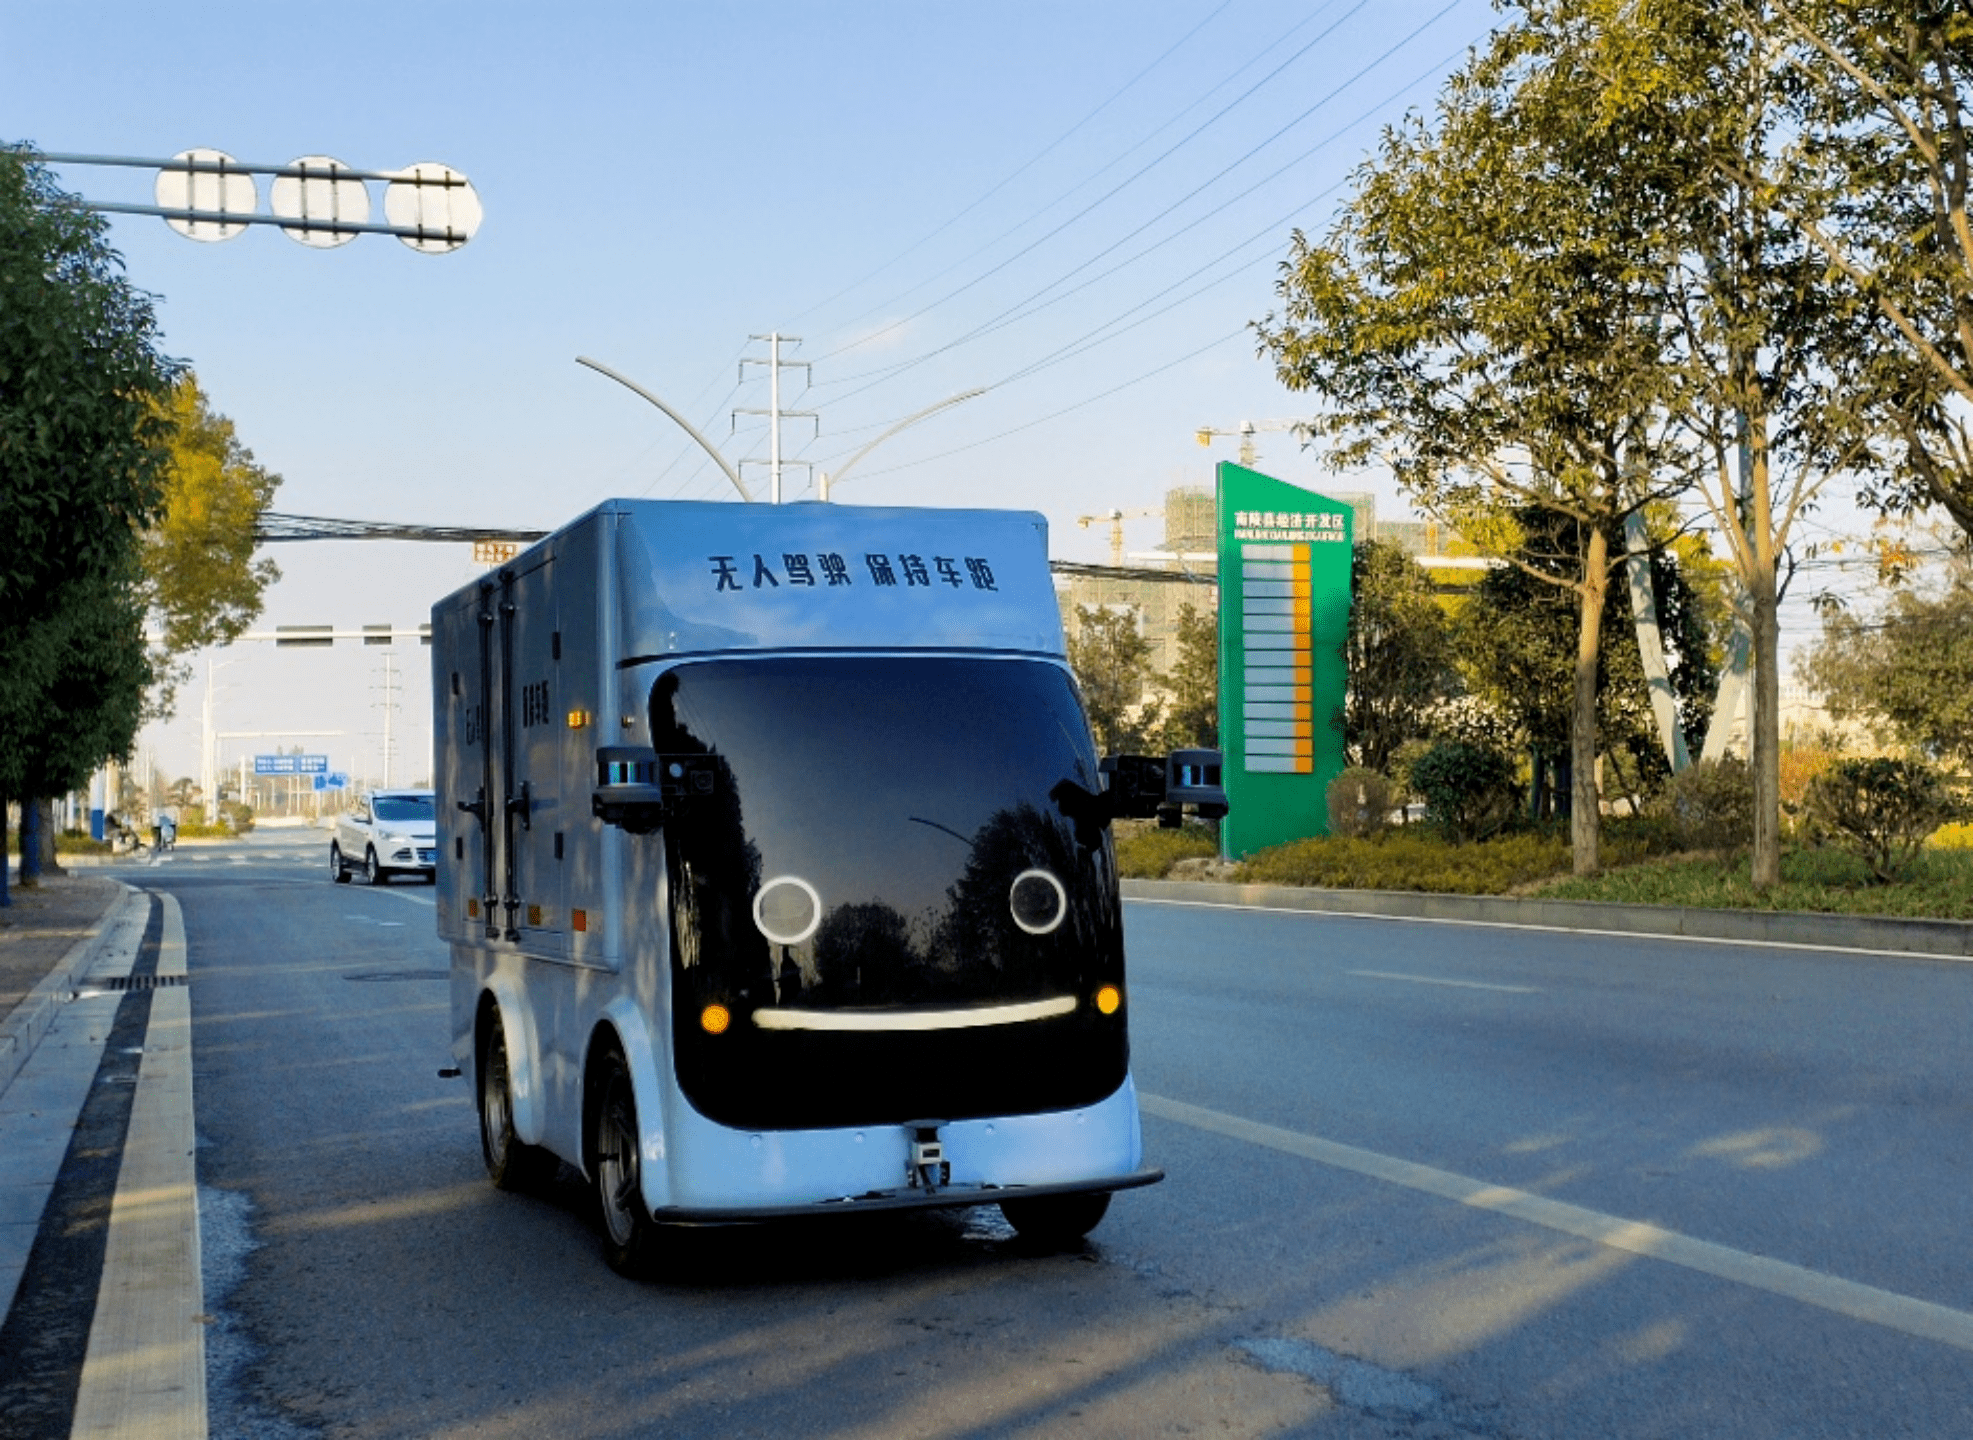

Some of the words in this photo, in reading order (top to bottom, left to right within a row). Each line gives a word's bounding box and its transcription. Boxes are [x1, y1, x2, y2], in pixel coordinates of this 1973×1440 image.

[708, 553, 852, 591] 无人驾驶
[864, 553, 998, 591] 保持车距
